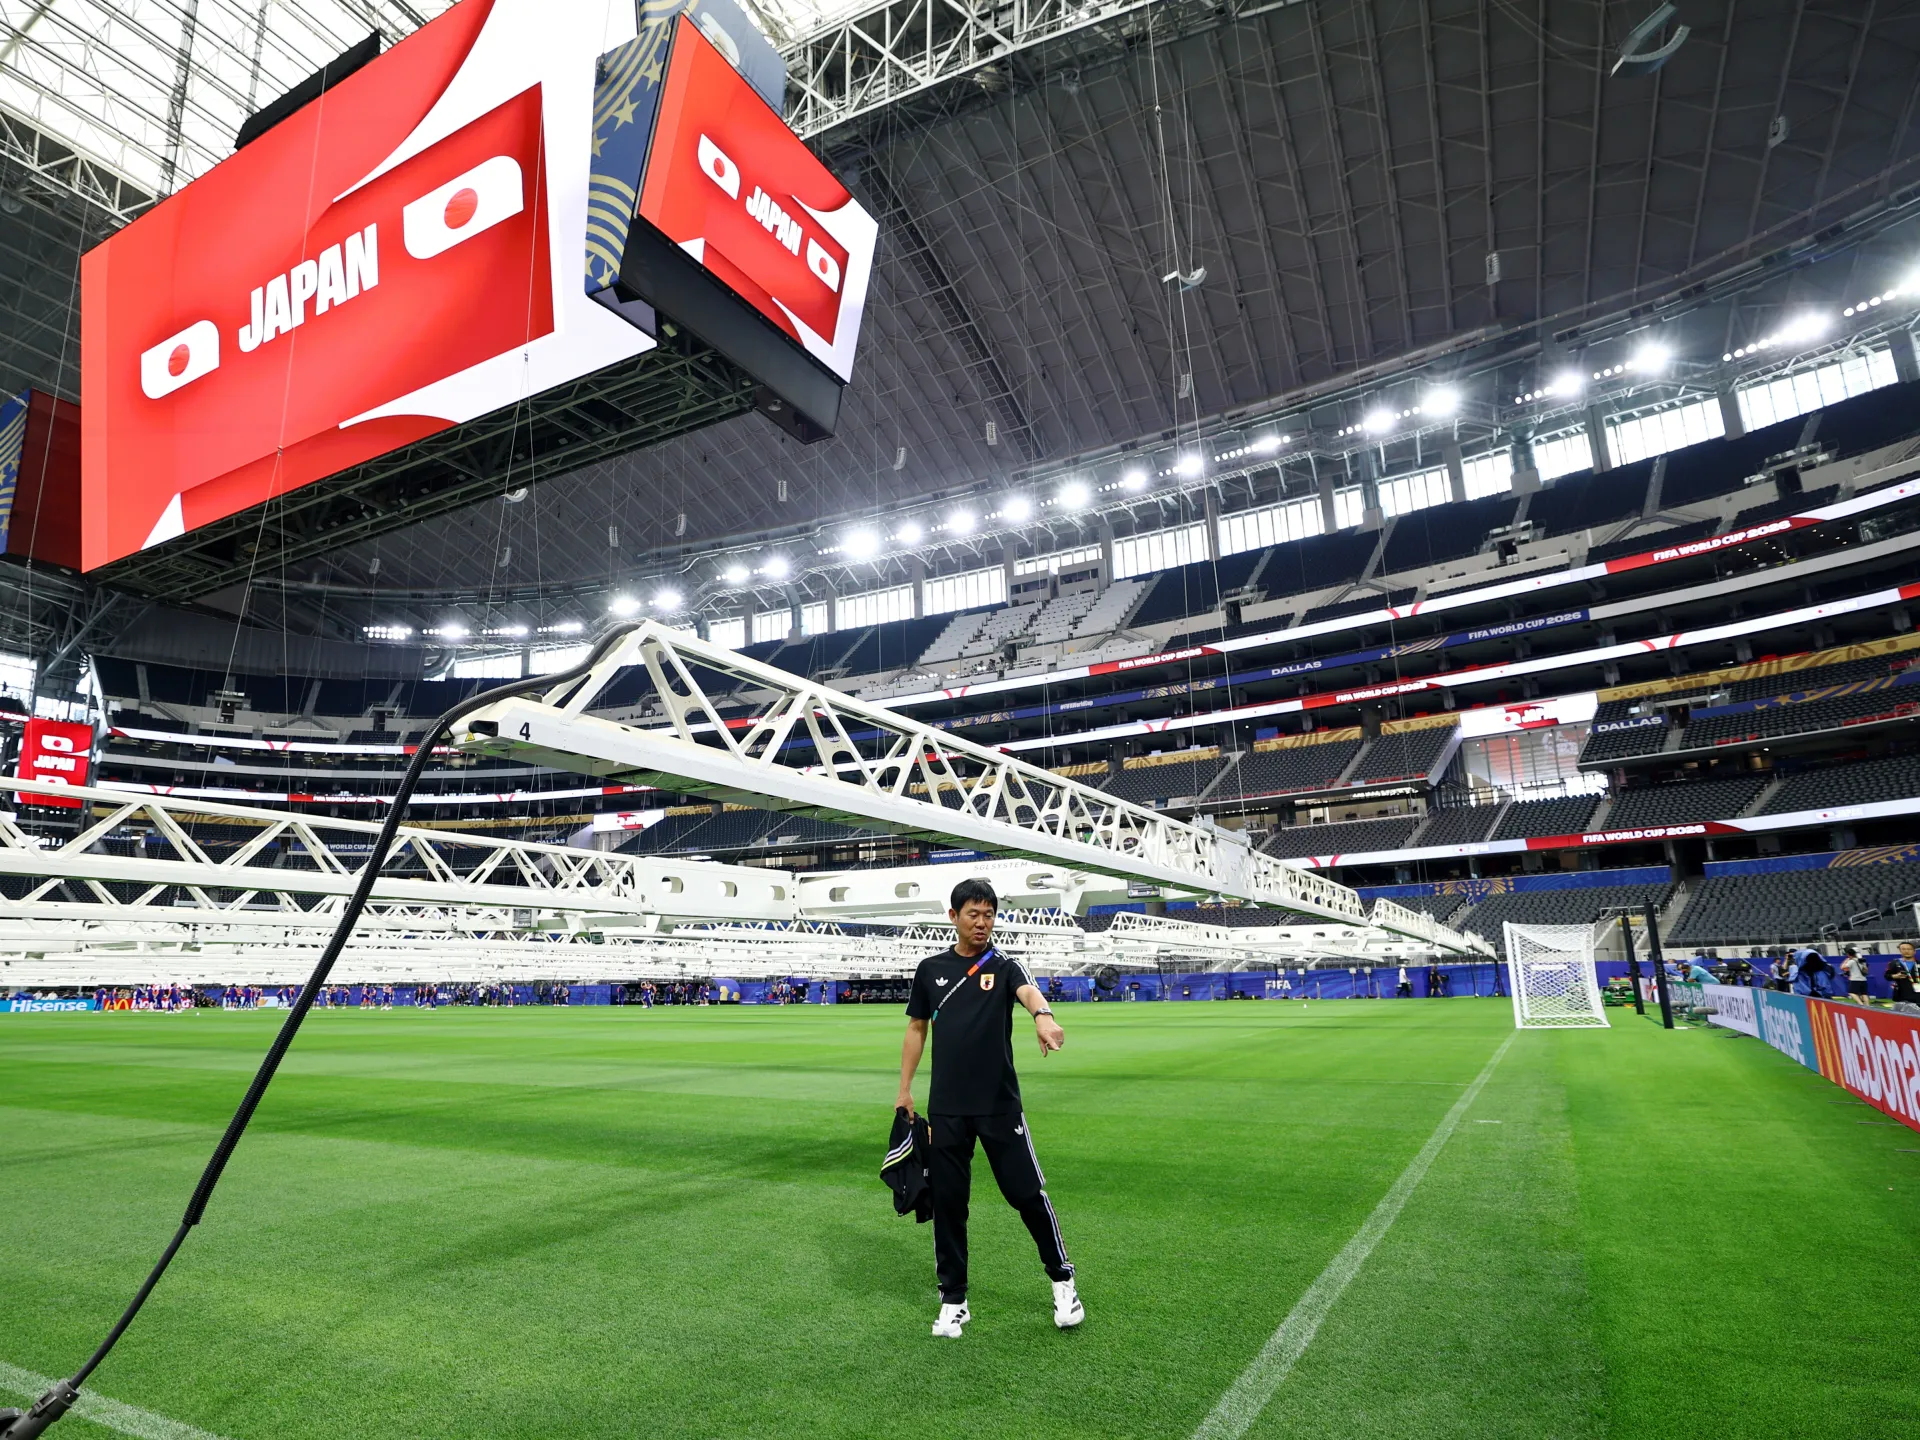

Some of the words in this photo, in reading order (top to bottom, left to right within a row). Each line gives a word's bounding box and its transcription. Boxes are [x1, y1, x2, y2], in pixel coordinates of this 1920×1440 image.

[745, 185, 803, 256] JAPAN
[238, 222, 379, 353] JAPAN
[1653, 549, 1679, 561] FIFA
[1678, 538, 1722, 555] WORLD
[1722, 532, 1747, 545] CUP
[1747, 520, 1792, 539] 2026
[1468, 630, 1489, 640] FIFA
[1489, 623, 1525, 636] WORLD
[1525, 619, 1545, 629] CUP
[1546, 611, 1582, 625] 2026
[1118, 661, 1134, 669] FIFA
[1135, 657, 1161, 667] WORLD
[1161, 653, 1175, 662] CUP
[1175, 648, 1203, 659] 2026
[1271, 660, 1322, 676] DALLAS
[1335, 693, 1354, 703] FIFA
[1354, 688, 1381, 700] WORLD
[1382, 686, 1398, 695] CUP
[1398, 681, 1428, 693] 2026
[519, 721, 531, 741] 4
[1597, 716, 1663, 733] DALLAS
[33, 754, 76, 772] JAPAN
[1582, 834, 1606, 843] FIFA
[1605, 830, 1643, 841] WORLD
[1643, 828, 1666, 837] CUP
[1666, 824, 1706, 836] 2026
[1264, 979, 1292, 990] FIFA
[10, 1000, 87, 1012] Hisense
[1758, 989, 1806, 1066] Hisense
